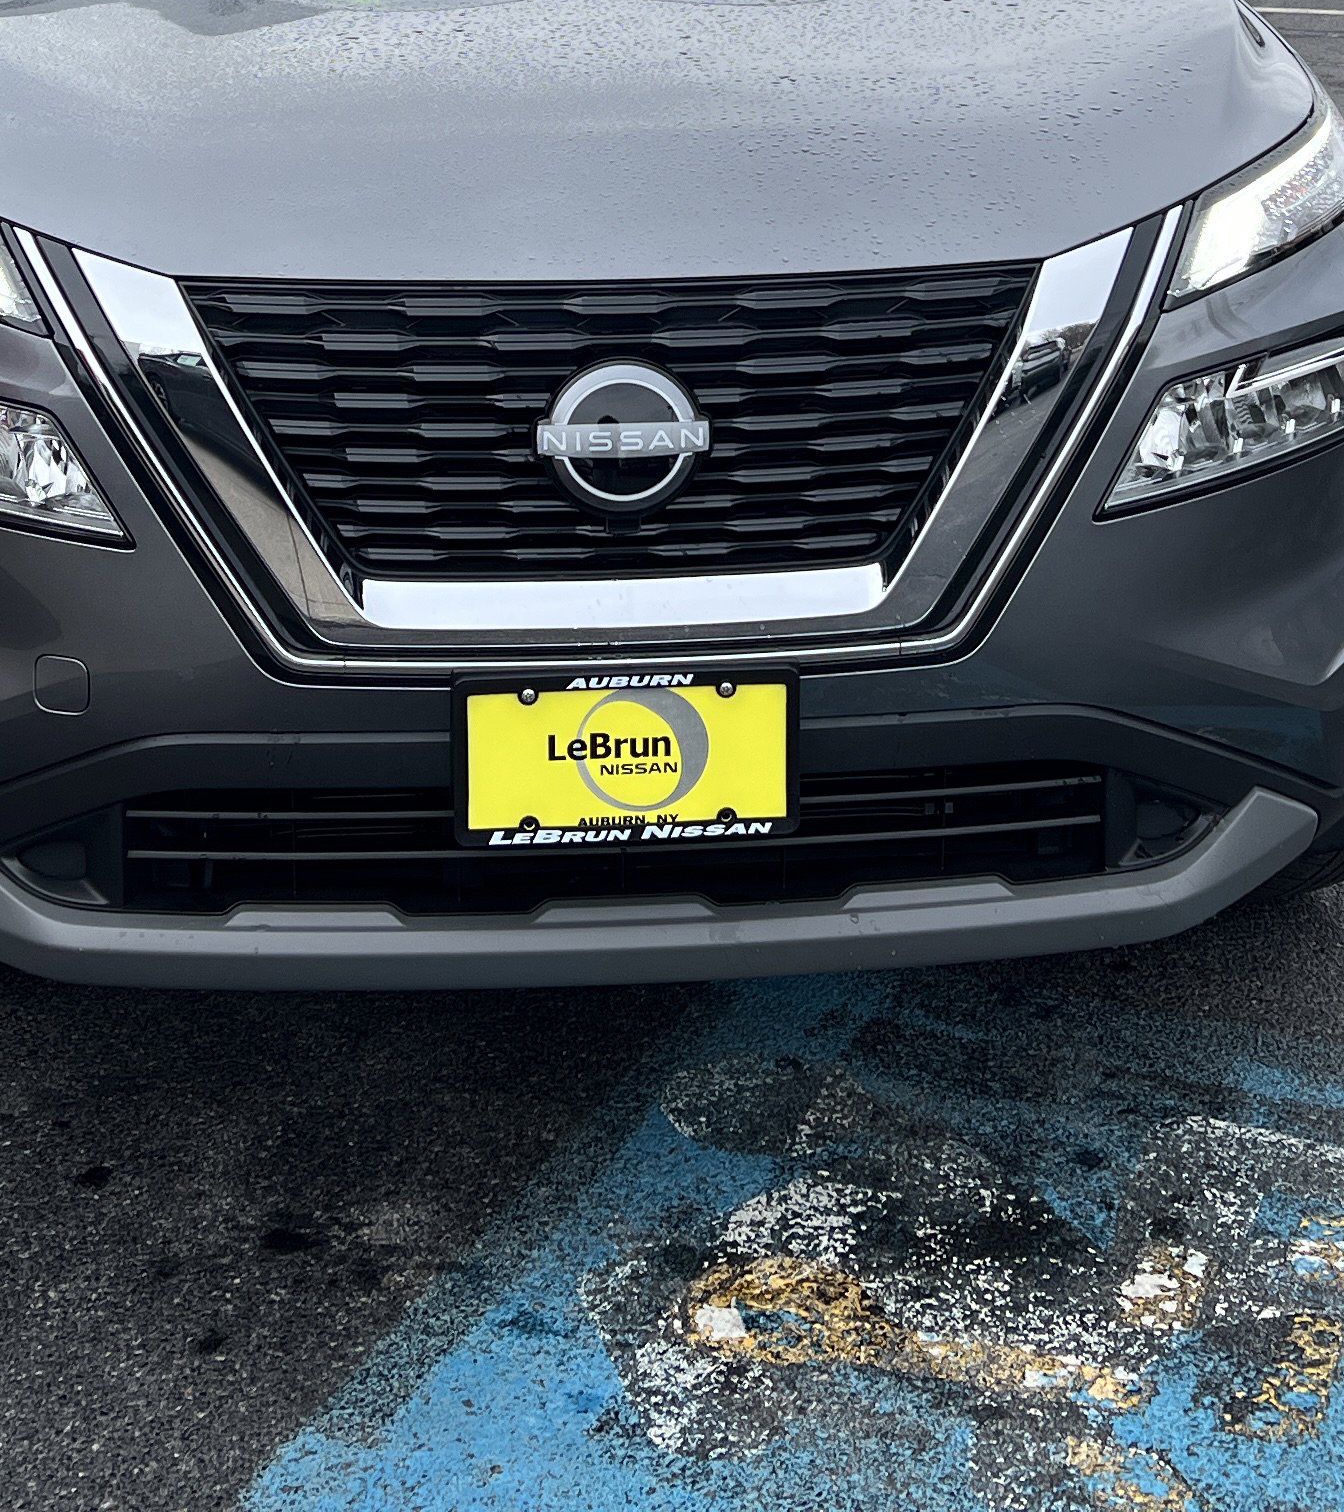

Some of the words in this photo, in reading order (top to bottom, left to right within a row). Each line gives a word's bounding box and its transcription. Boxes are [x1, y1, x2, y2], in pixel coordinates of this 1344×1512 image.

[543, 428, 705, 452] NISSAN
[565, 673, 695, 690] AUBURN
[548, 732, 672, 761] LeBrun
[600, 761, 679, 776] NISSAN
[656, 813, 679, 825] NY
